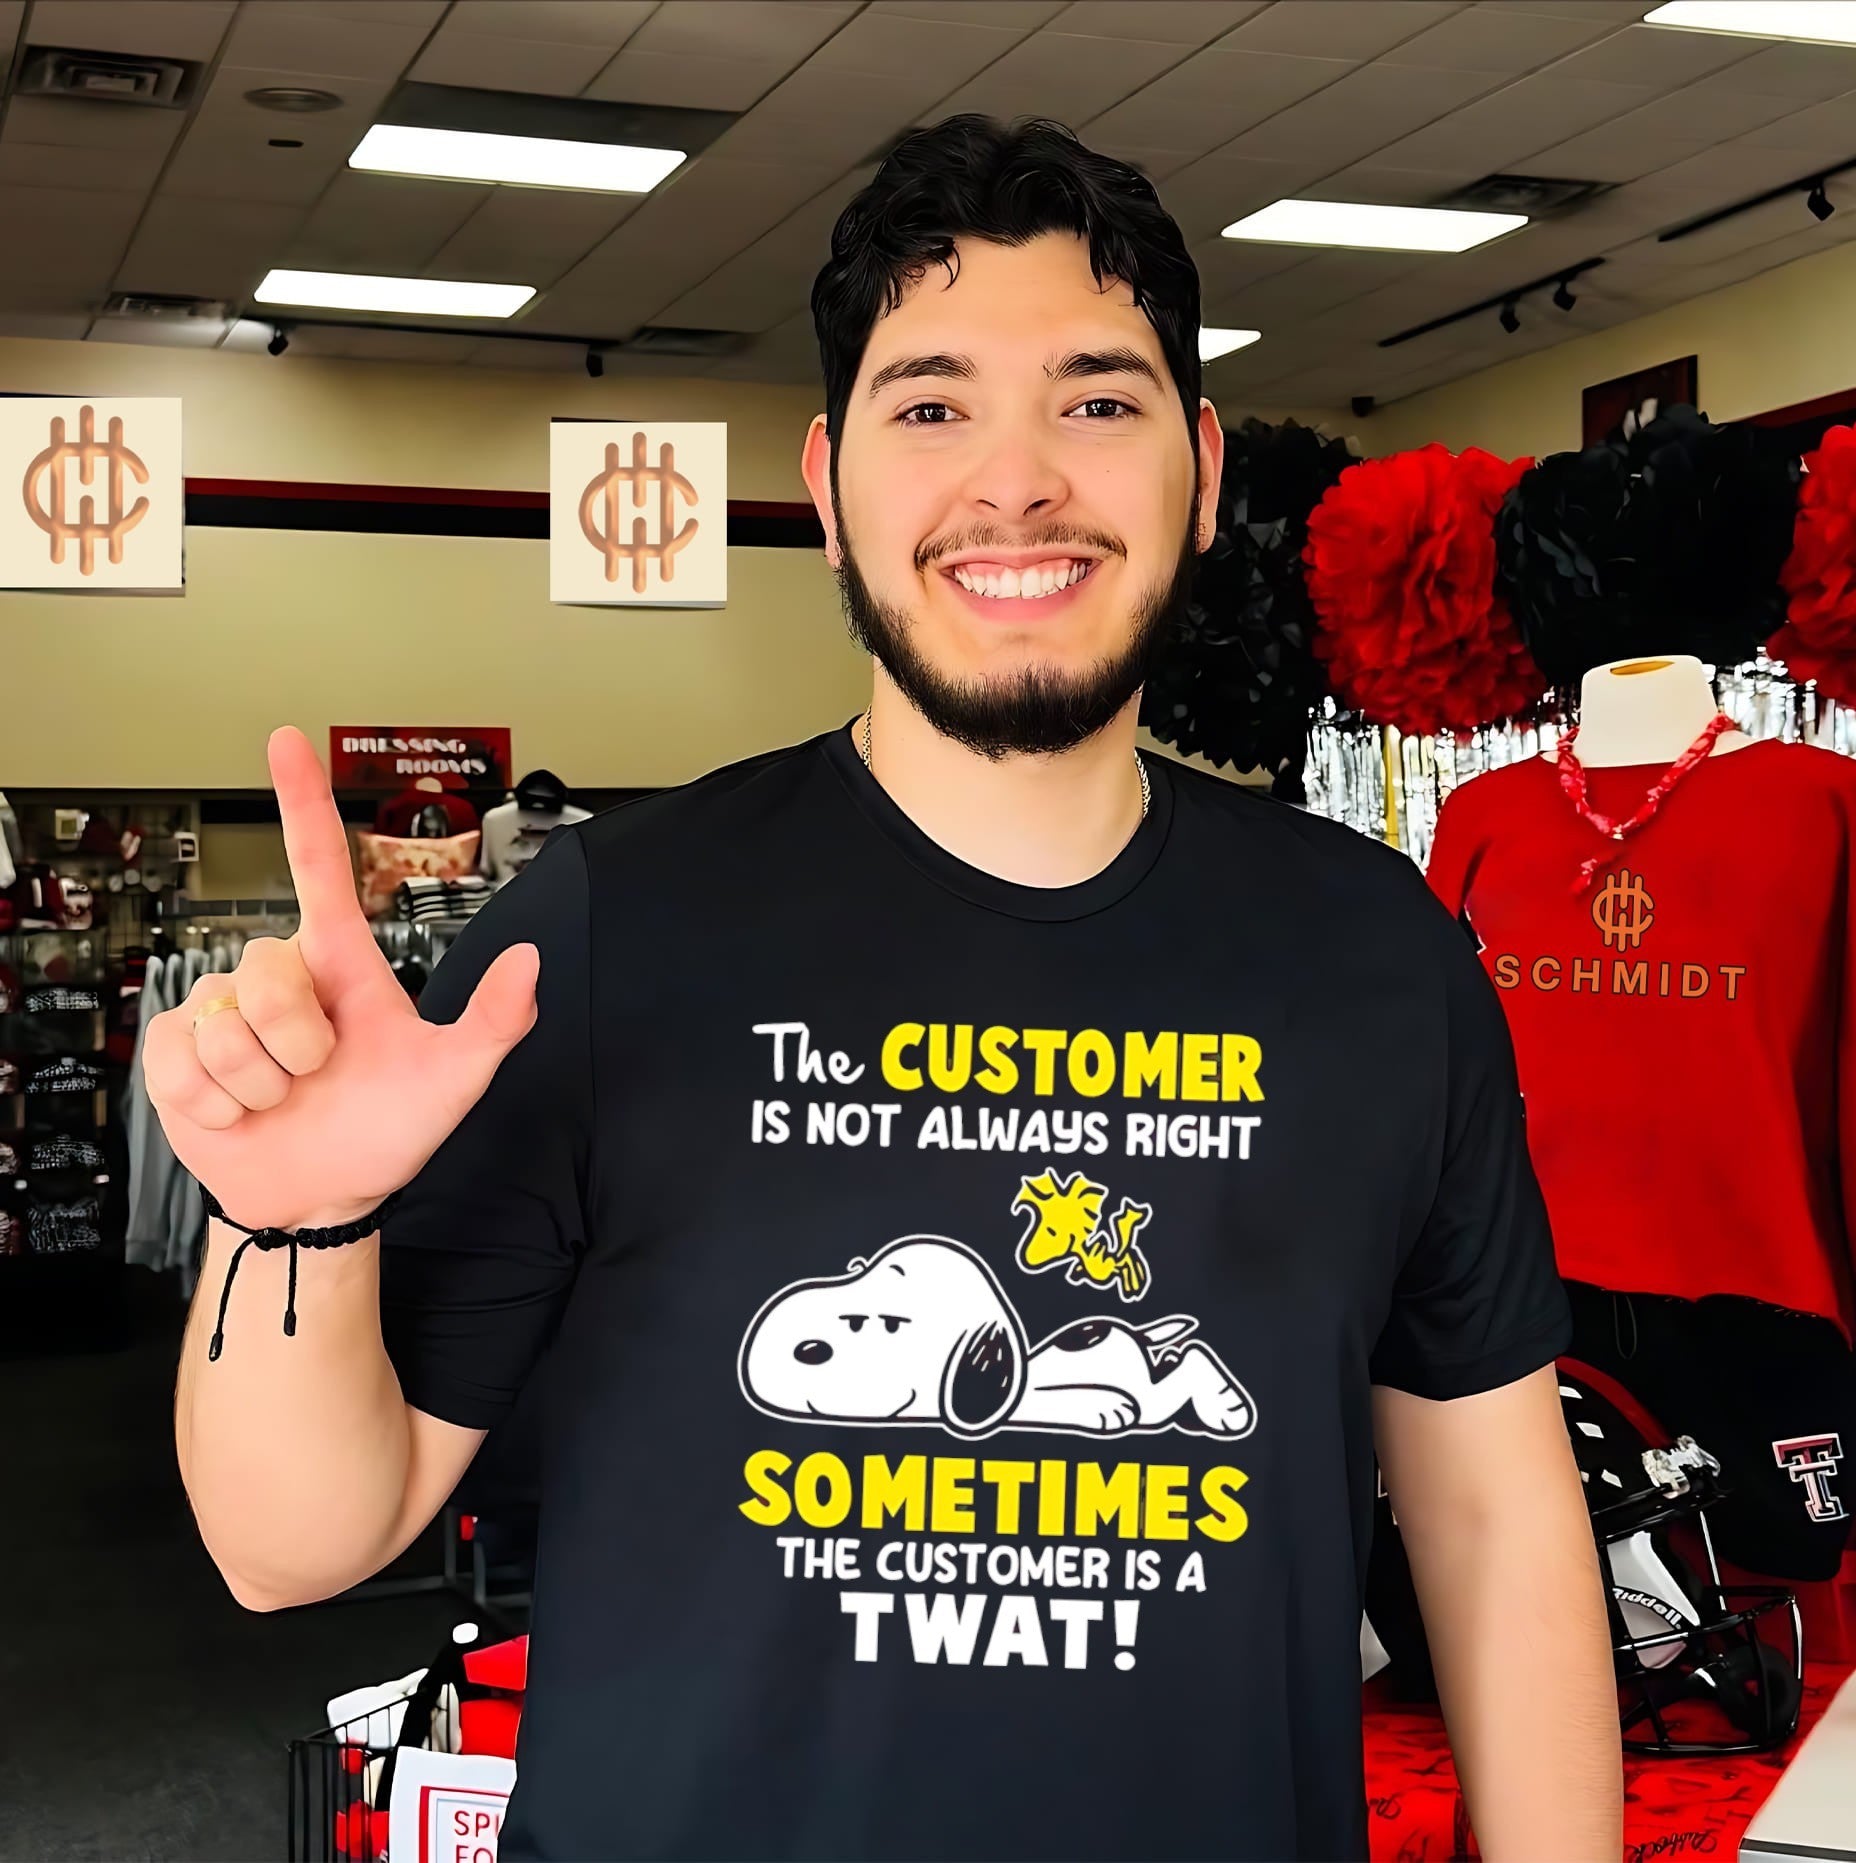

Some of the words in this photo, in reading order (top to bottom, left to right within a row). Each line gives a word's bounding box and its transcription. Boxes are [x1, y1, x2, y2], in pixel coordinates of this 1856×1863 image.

[342, 737, 467, 754] DRESSING
[396, 758, 487, 775] ROOMS
[1493, 953, 1747, 1001] SCHMIDT
[751, 1021, 866, 1085] The
[880, 1021, 1266, 1103] CUSTOMER
[750, 1099, 791, 1144] IS
[805, 1101, 902, 1148] NOT
[916, 1105, 1110, 1156] ALWAYS
[1124, 1111, 1262, 1160] RIGHT
[737, 1449, 1250, 1543] SOMETIMES
[775, 1536, 862, 1580] THE
[875, 1541, 1111, 1590] CUSTOMER
[1124, 1548, 1162, 1592] IS
[1174, 1550, 1207, 1593] A
[839, 1590, 1141, 1672] TWAT!
